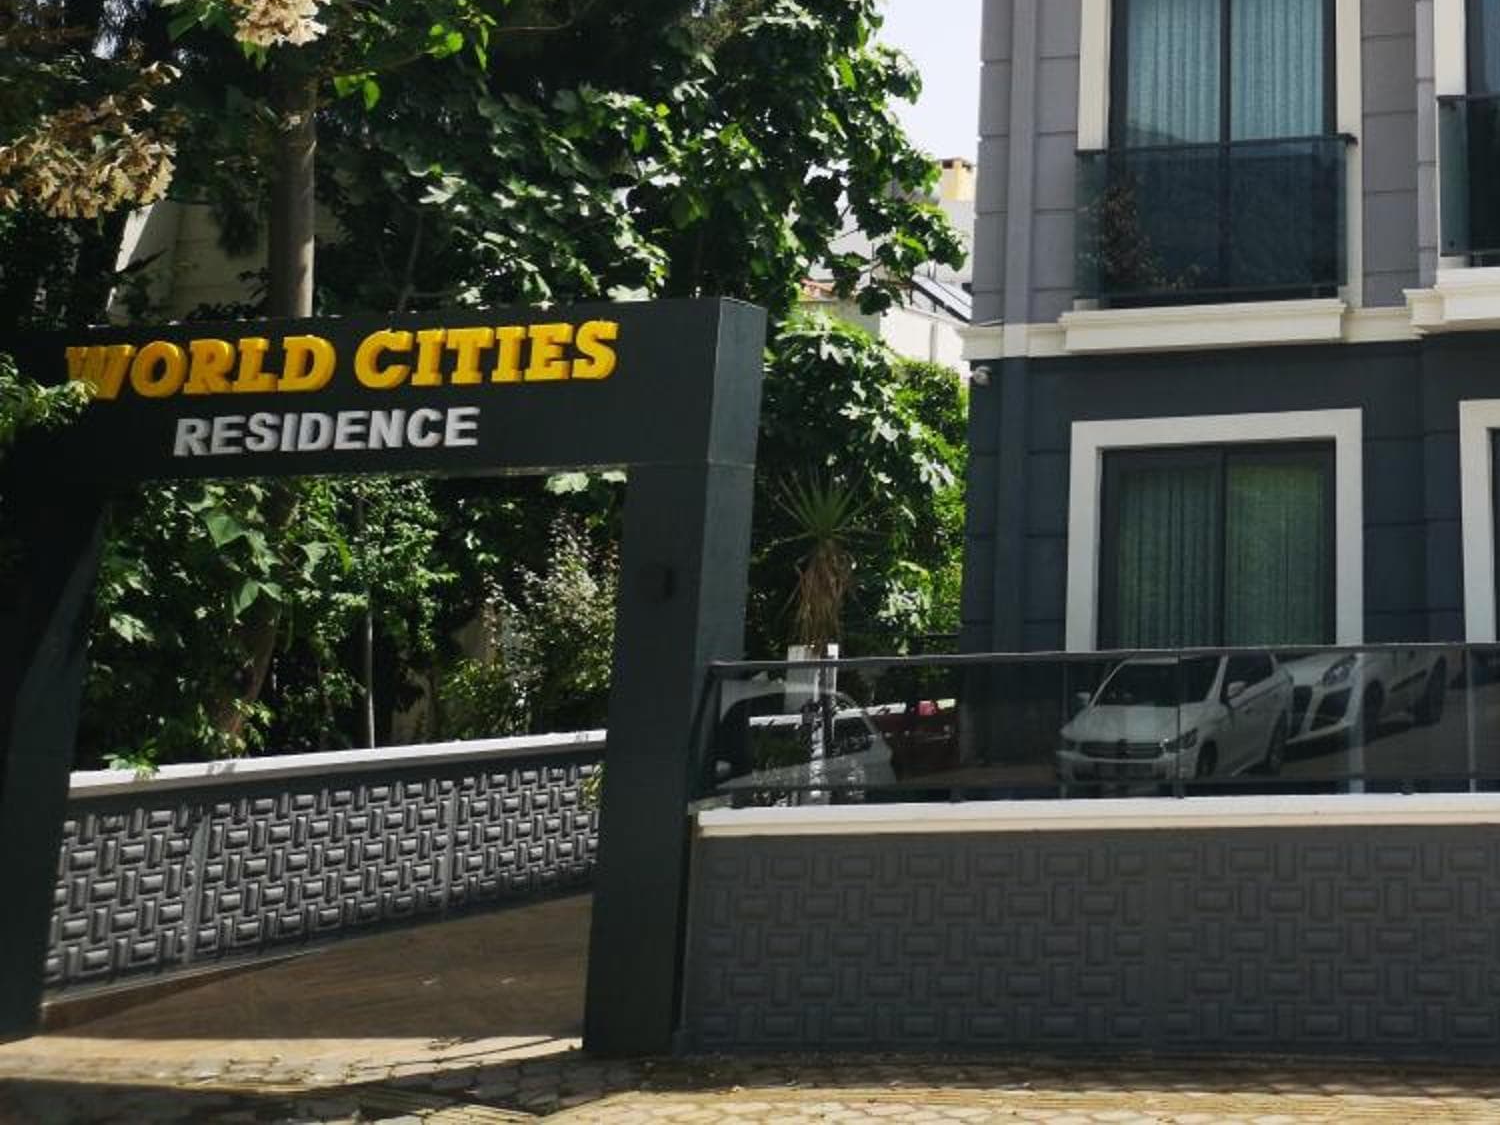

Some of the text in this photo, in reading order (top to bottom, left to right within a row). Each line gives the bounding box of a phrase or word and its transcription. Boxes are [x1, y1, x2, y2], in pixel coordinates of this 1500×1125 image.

[65, 320, 619, 400] WORLD CITIES
[173, 407, 481, 457] RESIDENCE
